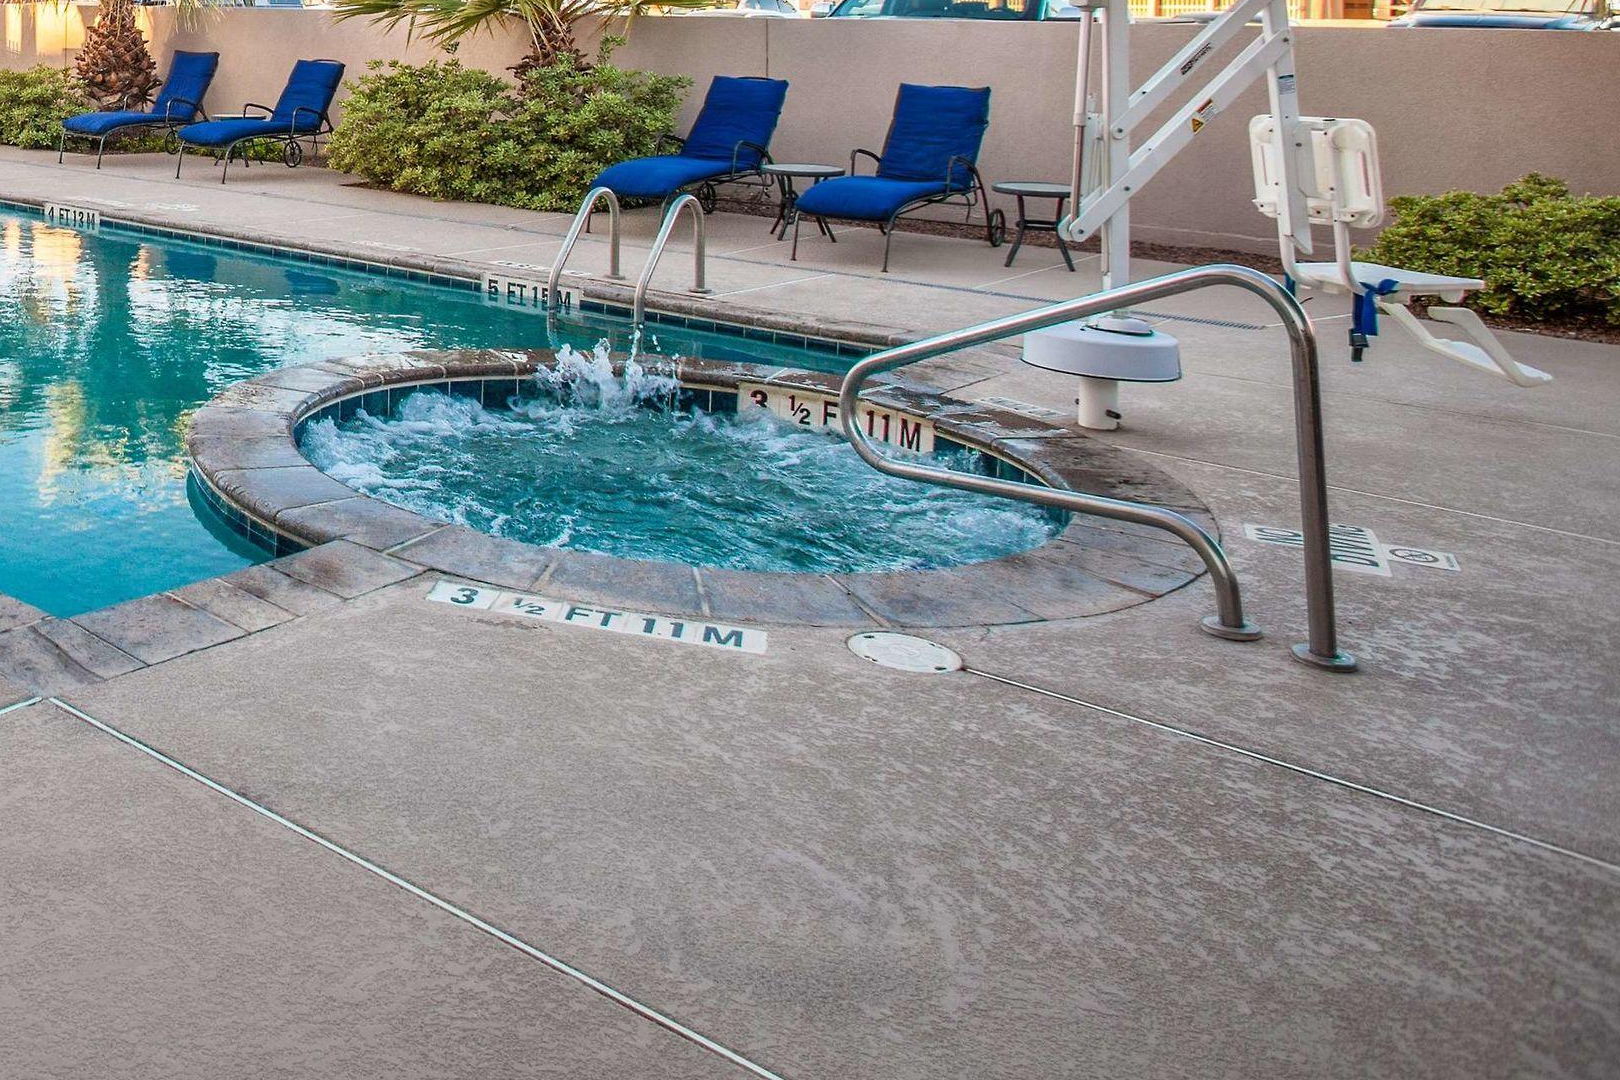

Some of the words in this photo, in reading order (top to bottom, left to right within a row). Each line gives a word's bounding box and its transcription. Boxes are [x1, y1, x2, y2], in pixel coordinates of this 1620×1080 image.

[488, 278, 499, 296] 5
[507, 282, 527, 299] FT
[556, 290, 571, 306] M
[900, 417, 922, 452] M
[450, 587, 480, 605] 3
[565, 605, 623, 627] FT
[702, 625, 744, 648] M
